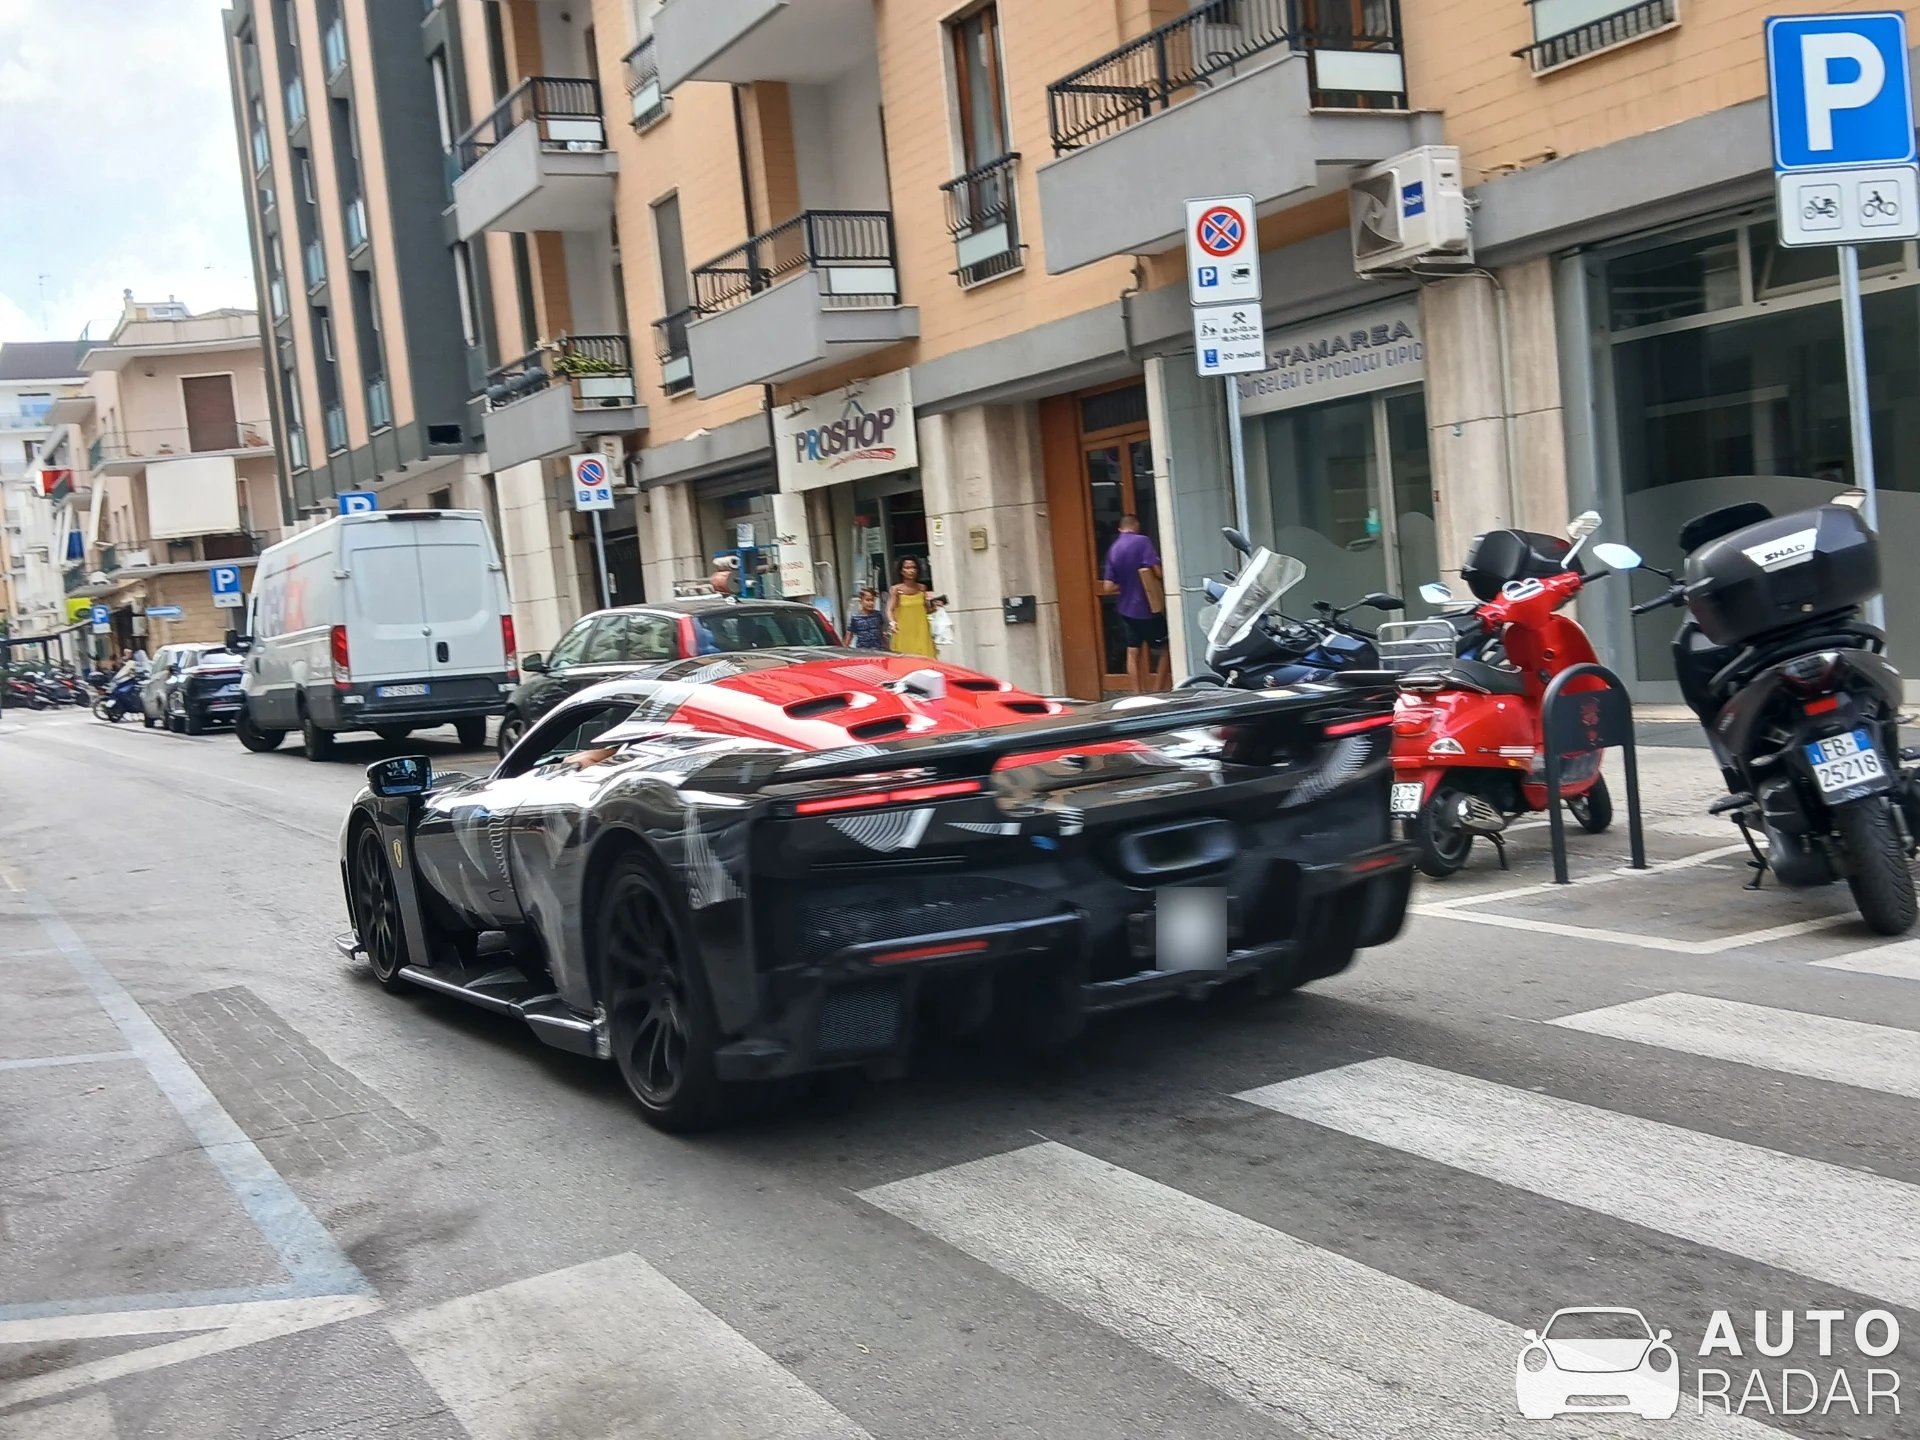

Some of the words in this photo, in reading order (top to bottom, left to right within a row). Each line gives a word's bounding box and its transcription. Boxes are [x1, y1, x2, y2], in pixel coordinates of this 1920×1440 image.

[1800, 32, 1886, 151] P
[1201, 268, 1215, 286] P
[1244, 320, 1414, 377] LTAMAREA
[1303, 367, 1314, 385] e
[793, 407, 895, 464] PROSHOP
[345, 496, 372, 515] P
[1764, 544, 1805, 562] SHAD
[216, 568, 236, 592] P
[93, 608, 107, 623] P
[1818, 754, 1878, 788] 25218
